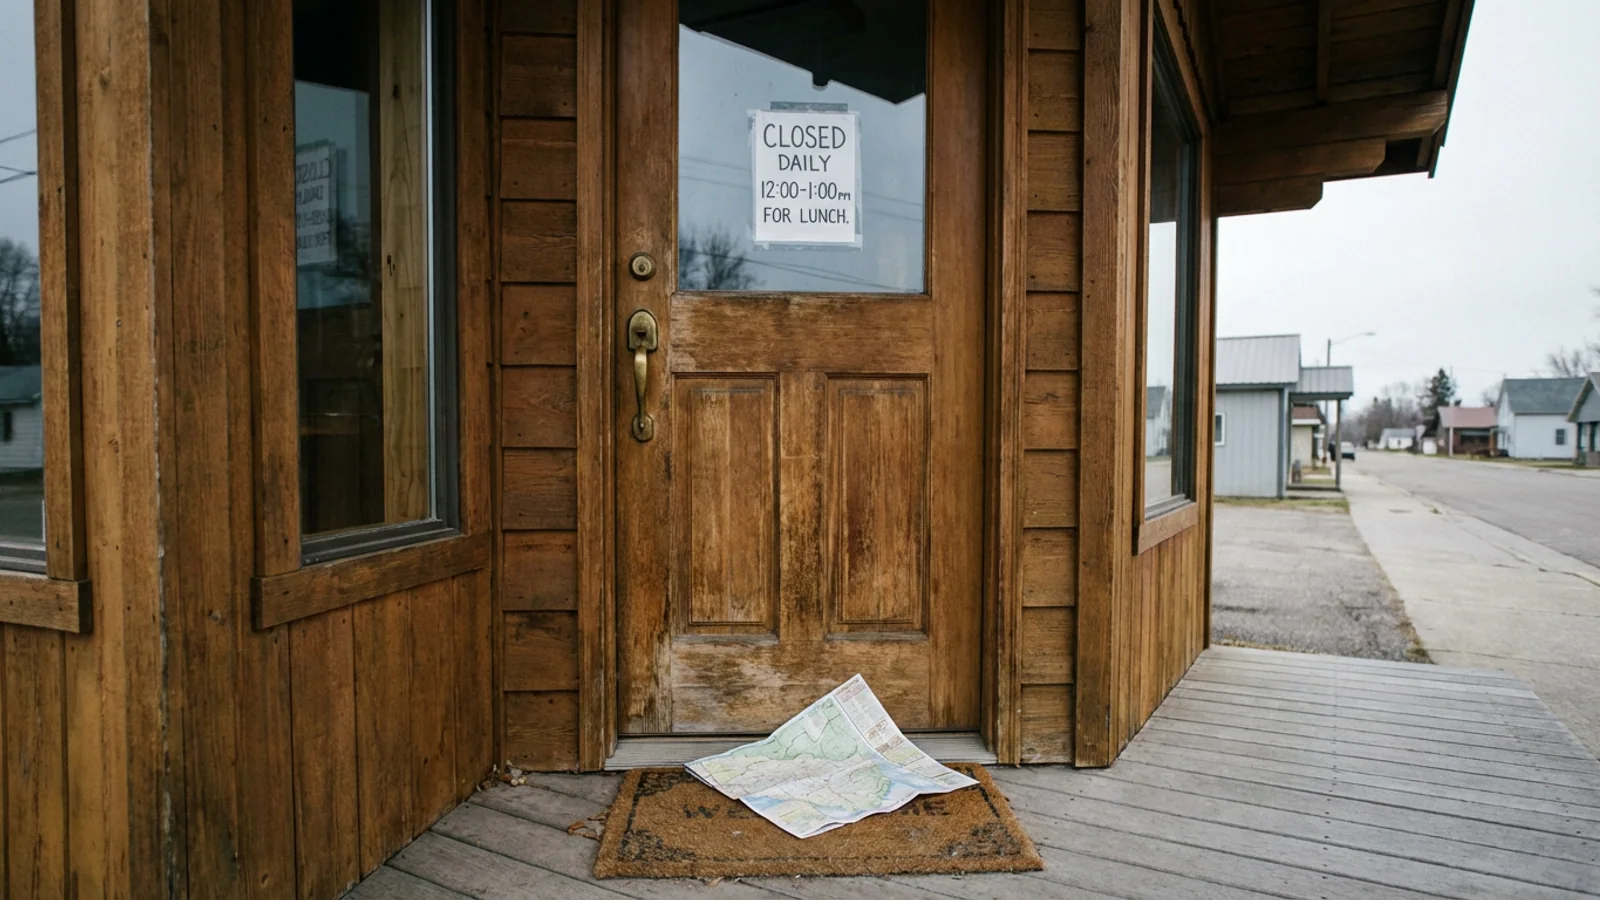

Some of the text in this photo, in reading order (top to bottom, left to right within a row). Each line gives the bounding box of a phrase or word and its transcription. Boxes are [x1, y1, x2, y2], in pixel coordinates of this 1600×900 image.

[763, 123, 846, 149] CLOSED
[778, 153, 831, 172] DAILY
[763, 207, 849, 224] FOR LUNCH.
